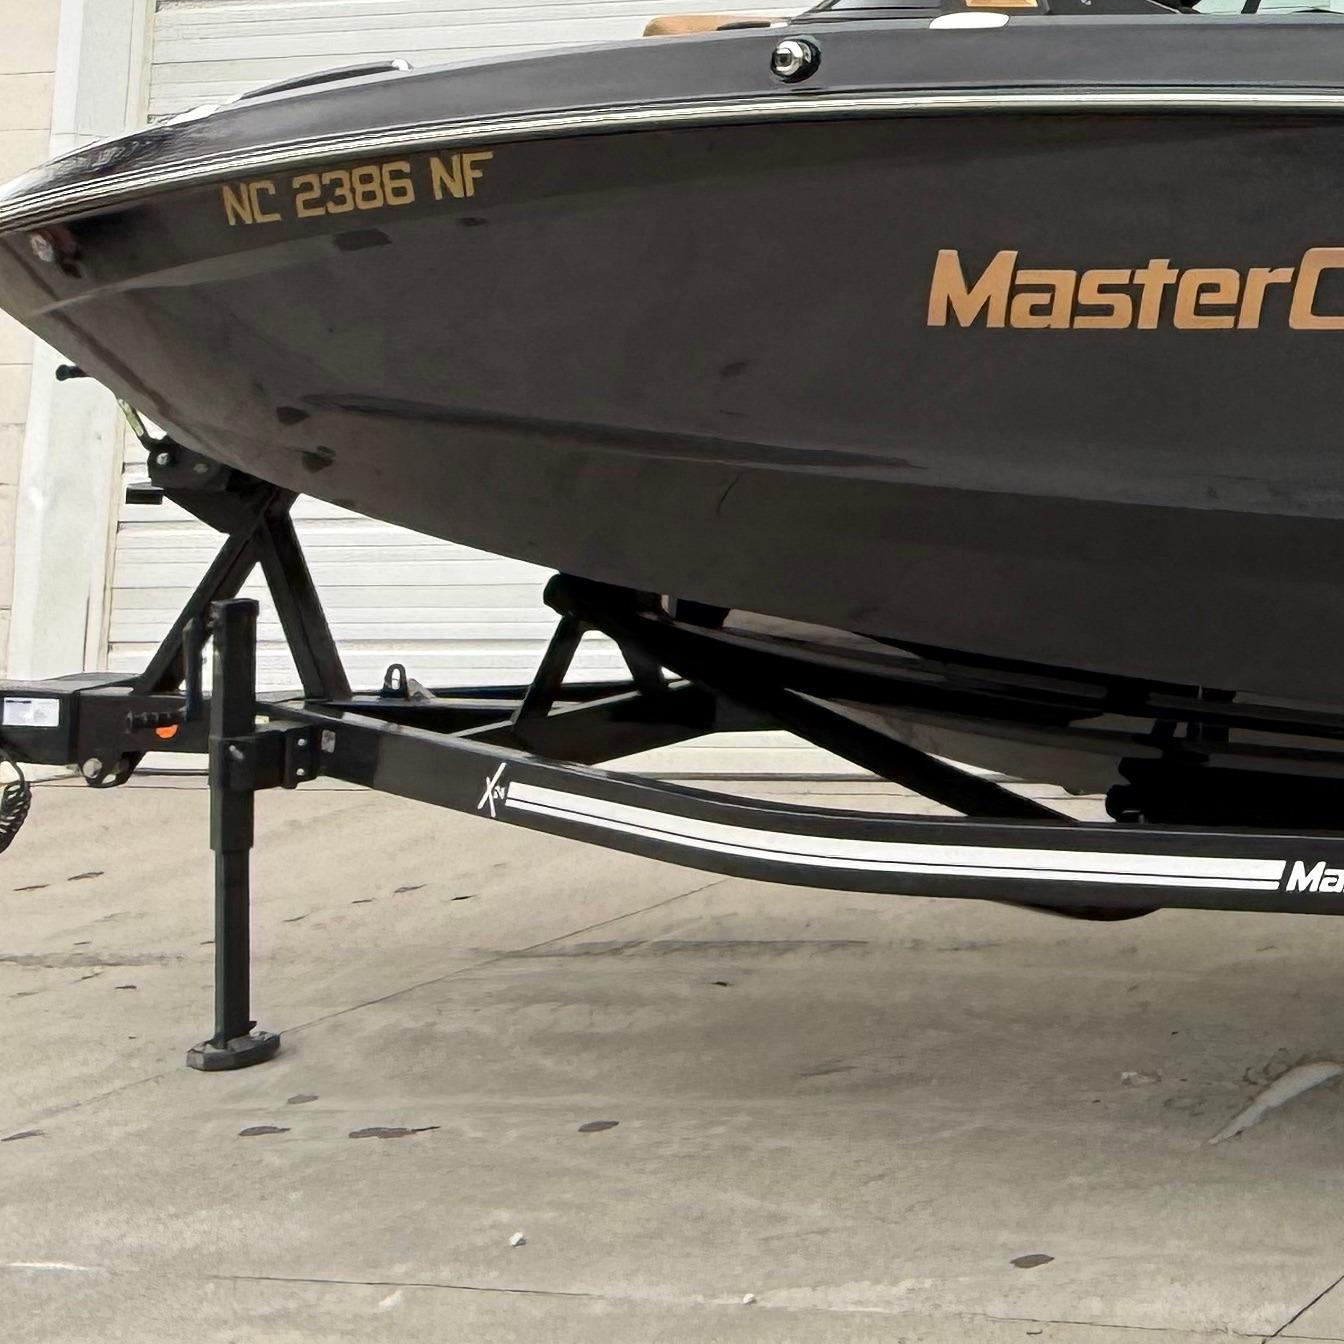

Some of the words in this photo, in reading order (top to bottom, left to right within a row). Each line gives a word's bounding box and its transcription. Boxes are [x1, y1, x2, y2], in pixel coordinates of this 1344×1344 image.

[222, 179, 282, 226] NC
[292, 161, 415, 218] 2386
[429, 151, 494, 201] NF
